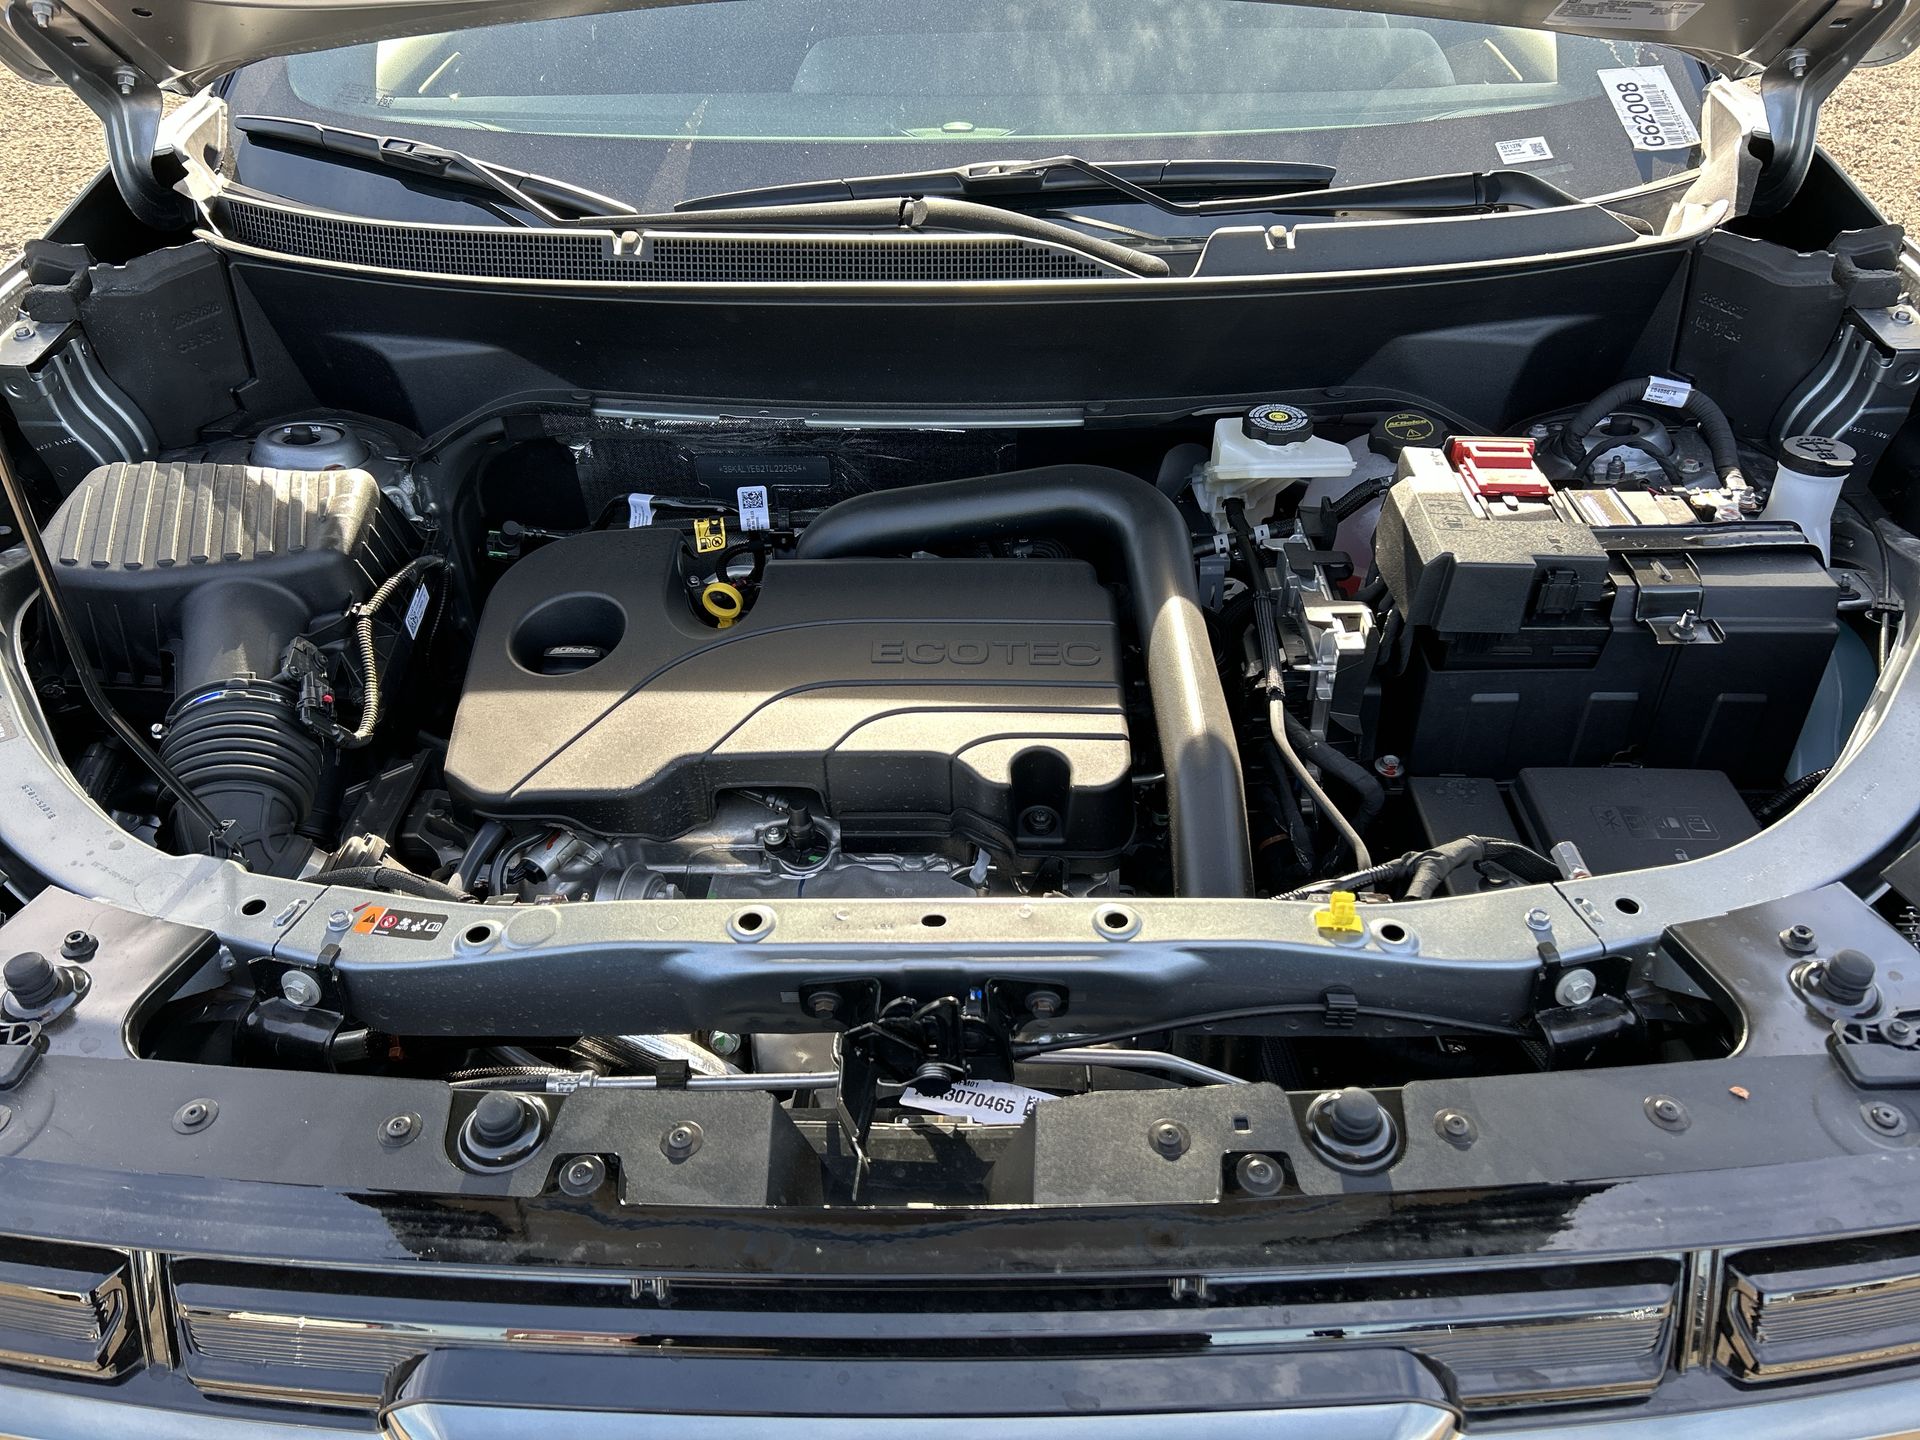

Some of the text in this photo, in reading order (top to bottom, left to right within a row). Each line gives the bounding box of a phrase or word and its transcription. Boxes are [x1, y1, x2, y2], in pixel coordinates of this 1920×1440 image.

[1616, 82, 1666, 146] G62008
[871, 639, 1104, 666] ECOTEC
[914, 1088, 1016, 1114] 3070465
